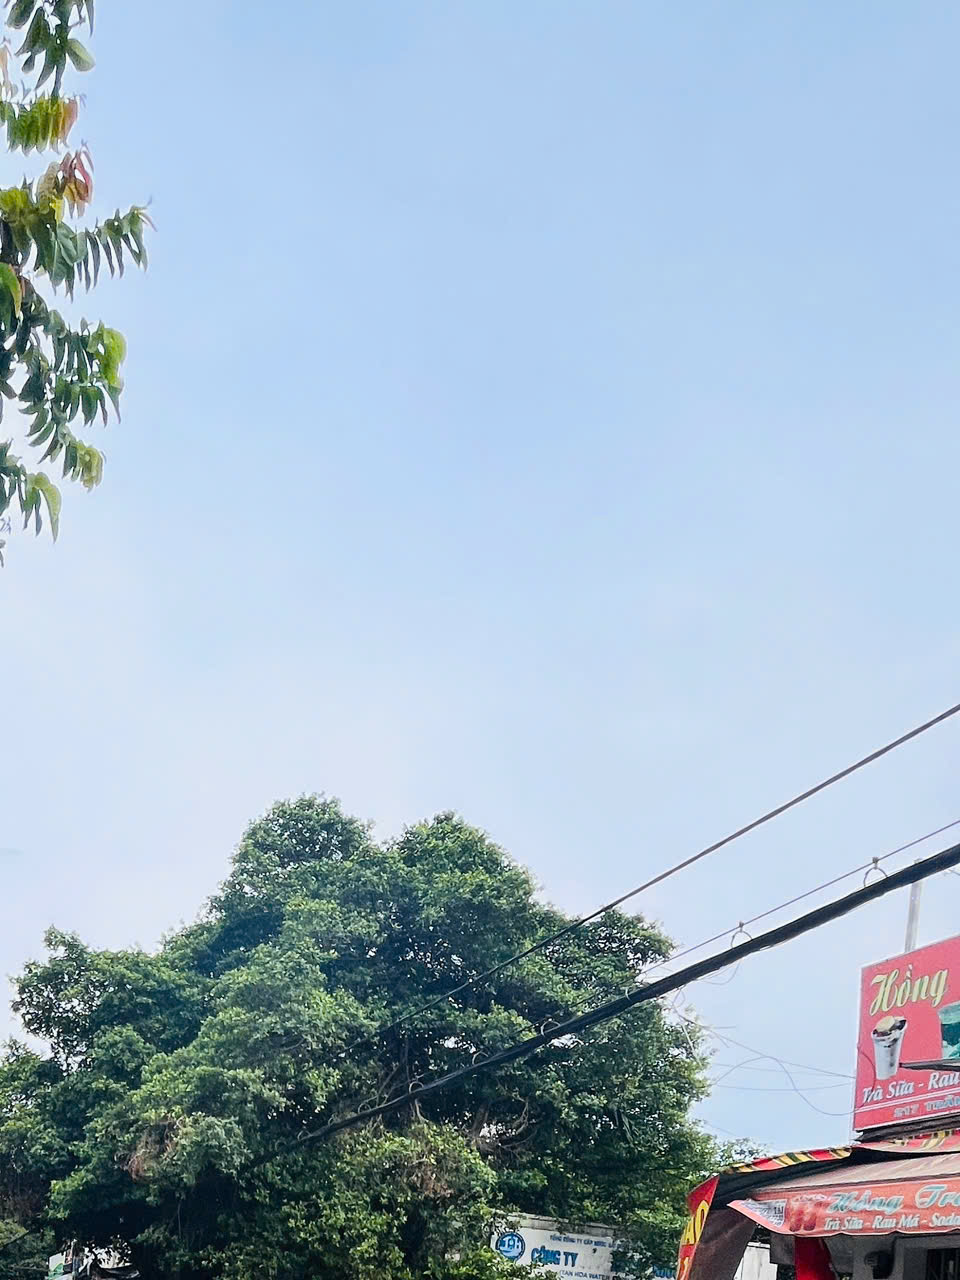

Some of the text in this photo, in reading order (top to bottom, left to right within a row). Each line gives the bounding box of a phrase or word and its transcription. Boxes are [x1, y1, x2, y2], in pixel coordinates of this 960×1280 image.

[869, 964, 949, 1016] Hồng
[862, 1086, 883, 1103] Trà
[886, 1079, 915, 1098] Sữa
[872, 1215, 897, 1229] Rau
[563, 1251, 578, 1267] TY
